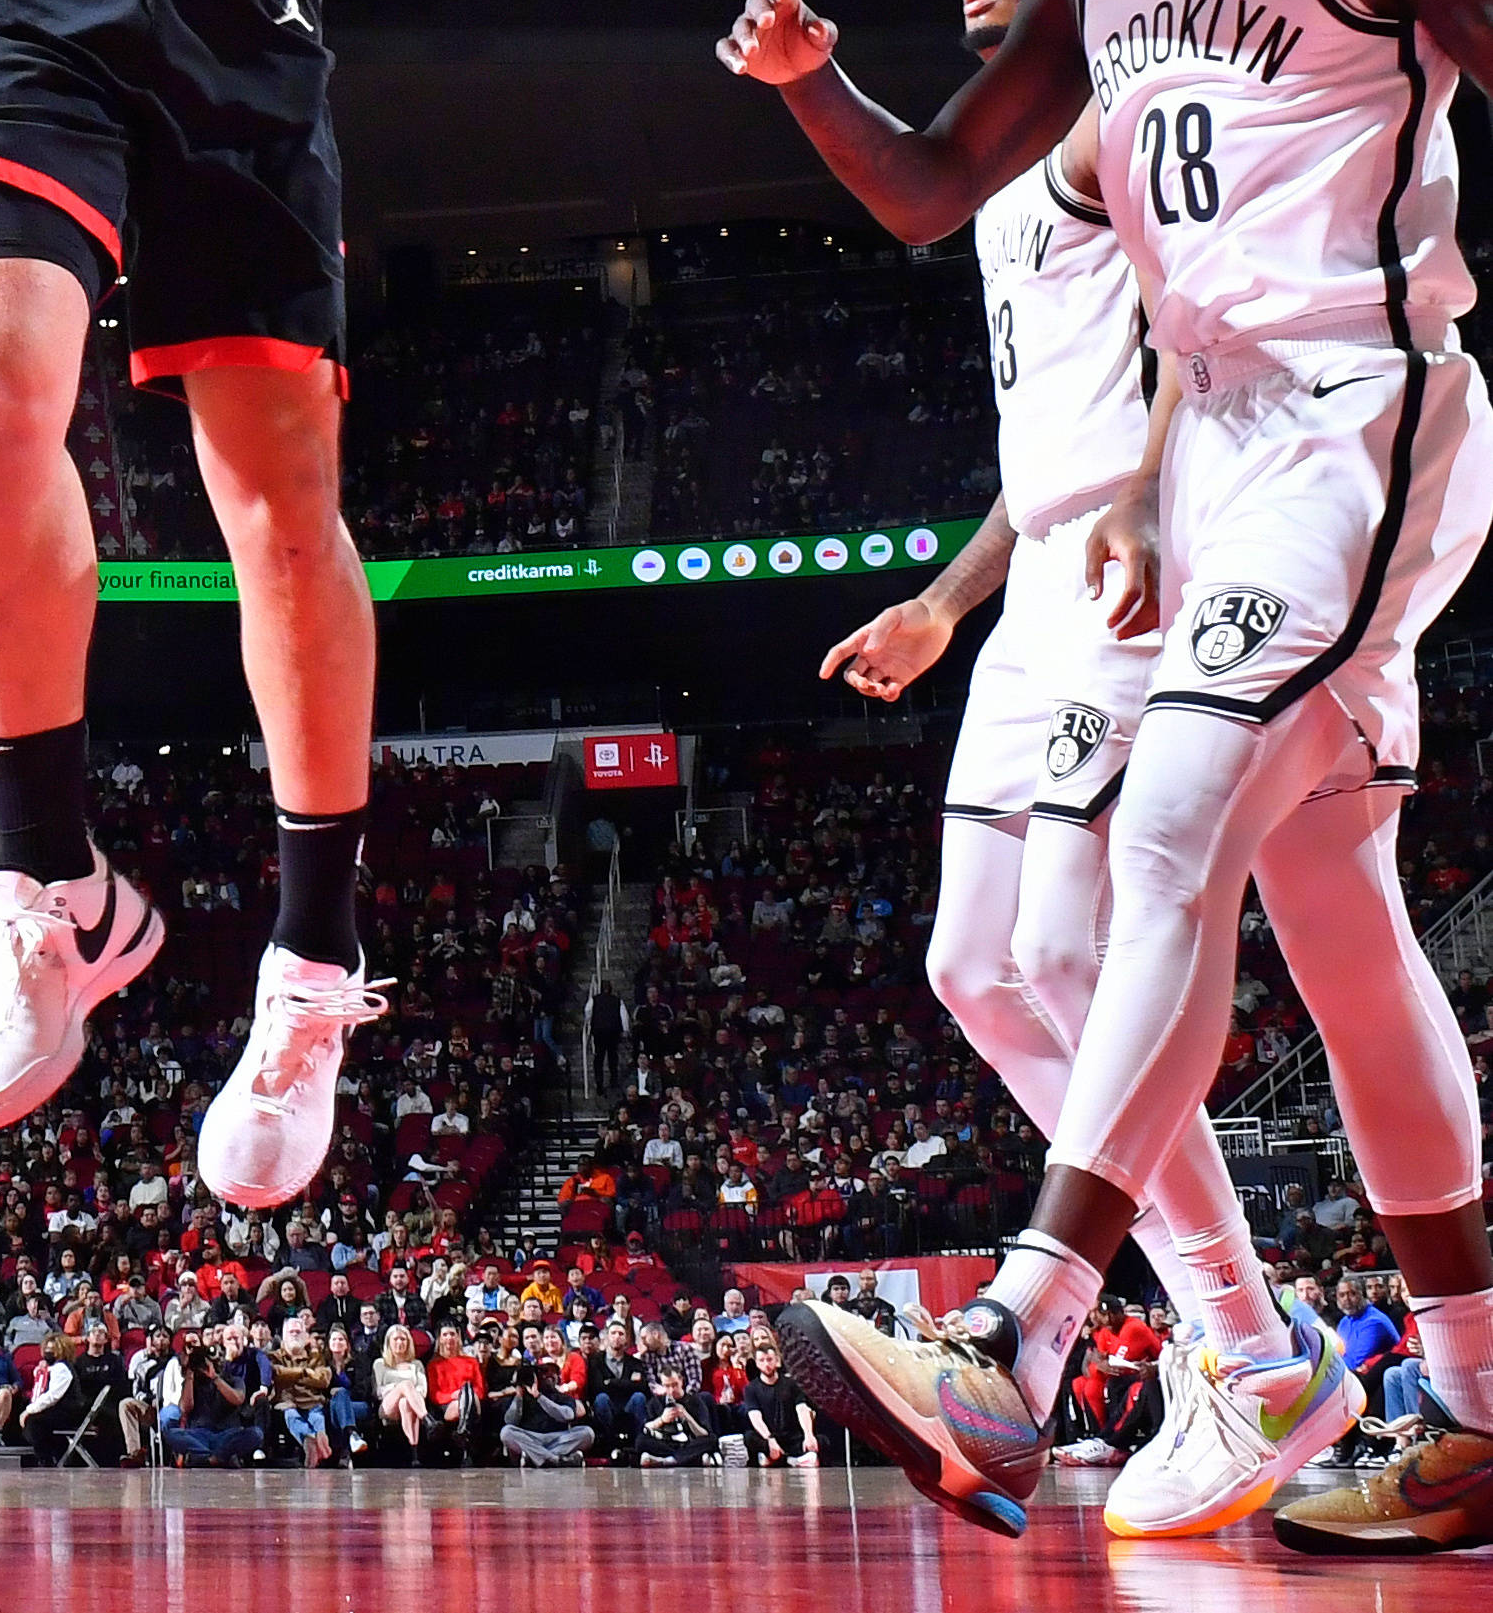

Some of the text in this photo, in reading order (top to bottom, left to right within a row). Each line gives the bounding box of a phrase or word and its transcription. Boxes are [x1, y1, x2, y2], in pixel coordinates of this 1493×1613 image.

[1141, 102, 1221, 227] 28
[97, 570, 237, 593] your financial
[468, 563, 574, 582] creditkarma
[1193, 593, 1278, 634] NETS
[399, 743, 486, 766] ULTRA
[592, 770, 624, 778] TOYOTA
